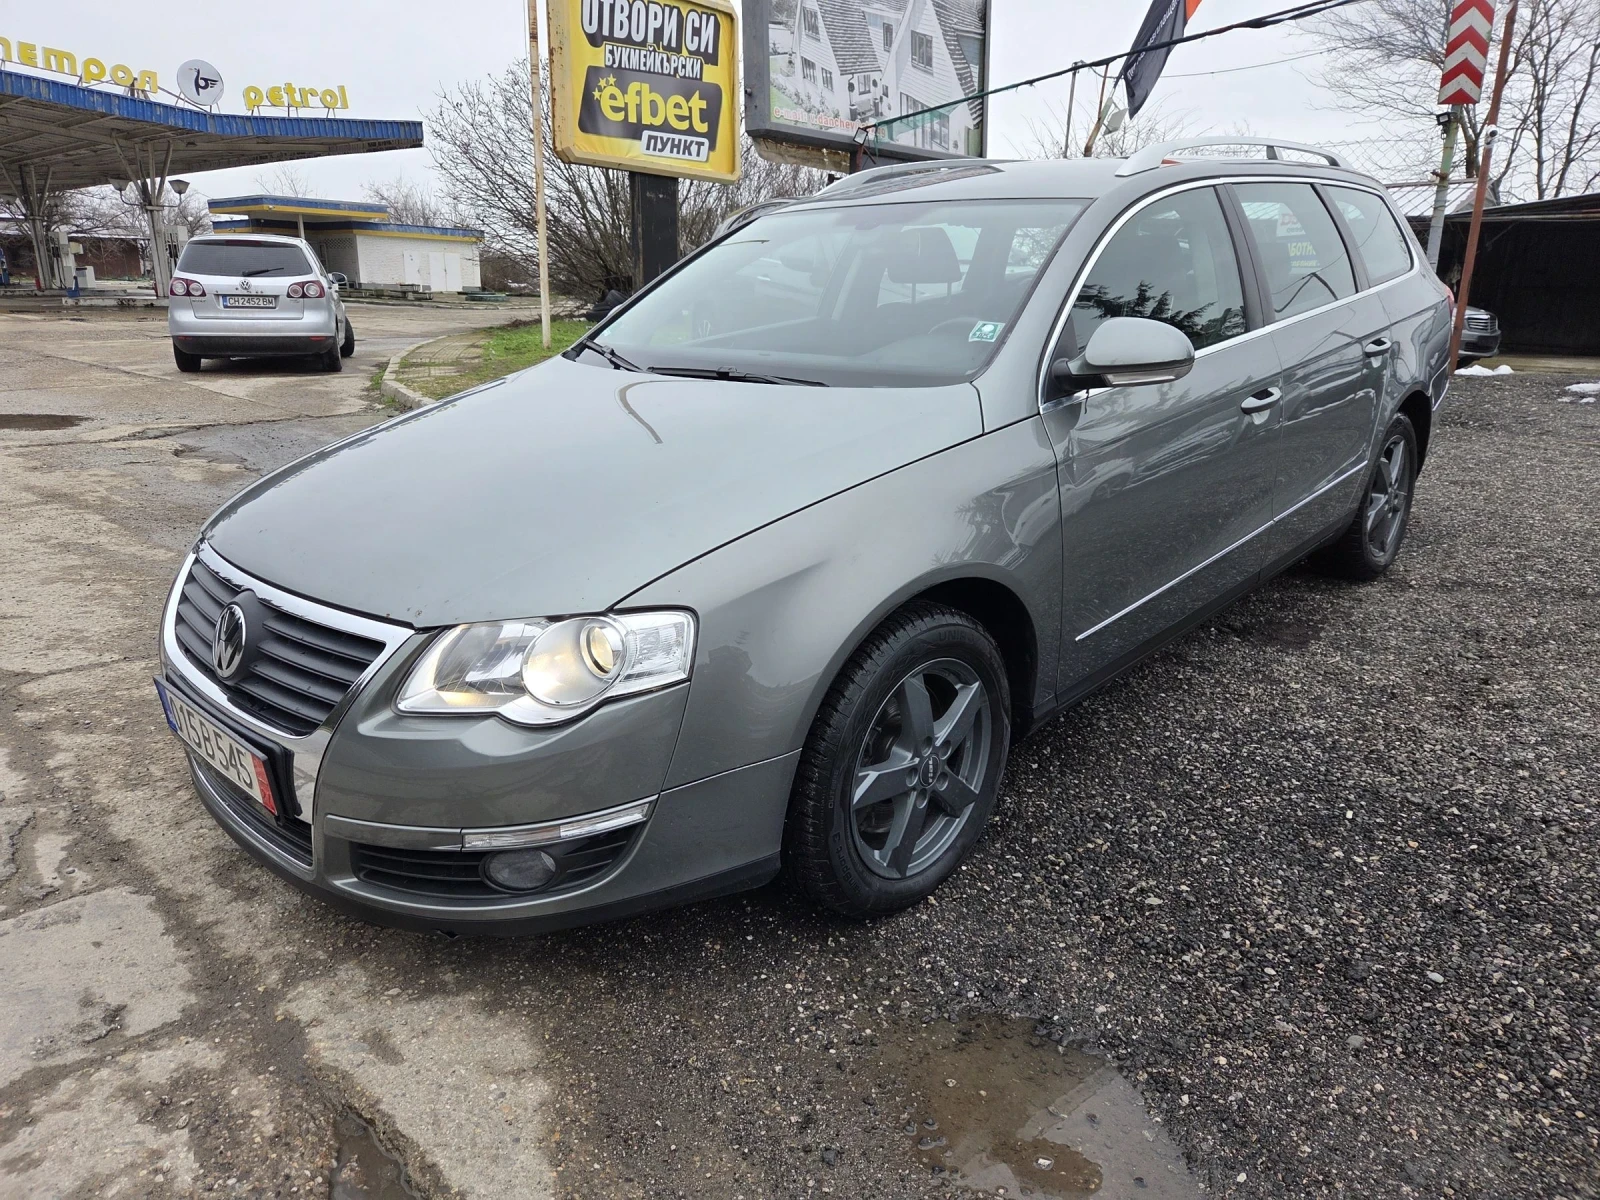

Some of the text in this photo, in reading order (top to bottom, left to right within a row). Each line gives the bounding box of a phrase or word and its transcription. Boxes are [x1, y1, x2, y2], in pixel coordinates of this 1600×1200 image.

[582, 0, 716, 54] ОТВОРИ СИ
[605, 44, 701, 79] БУКМЕЙКЪРСКИ
[243, 83, 349, 110] petrol
[600, 81, 708, 133] efbet
[646, 134, 705, 157] ПУНКТ
